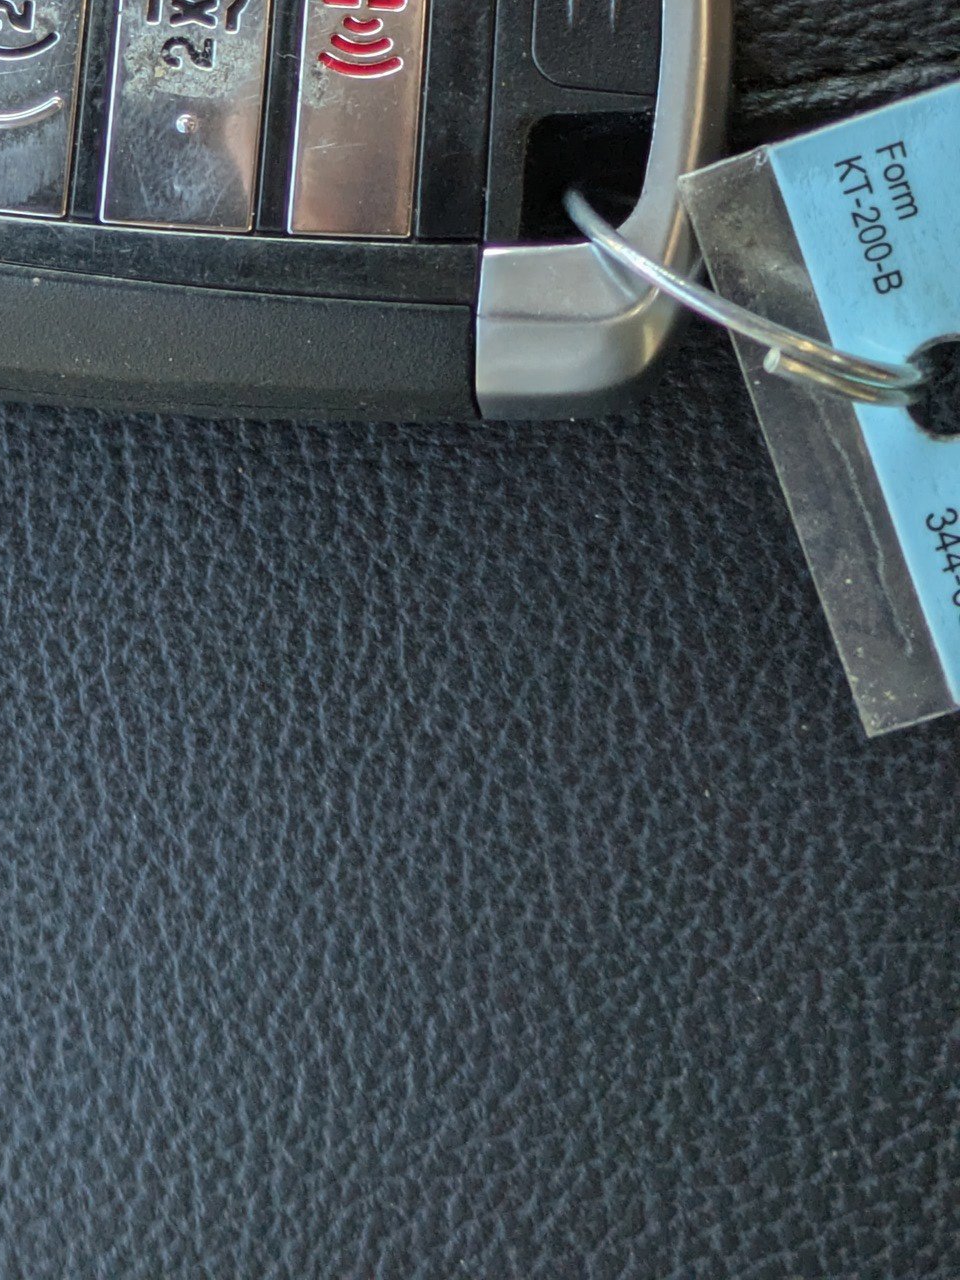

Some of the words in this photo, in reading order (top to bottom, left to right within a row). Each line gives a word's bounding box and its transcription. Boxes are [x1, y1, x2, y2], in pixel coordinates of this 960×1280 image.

[834, 155, 903, 295] KT-200-B
[875, 140, 918, 220] Form
[925, 507, 960, 610] 344-
